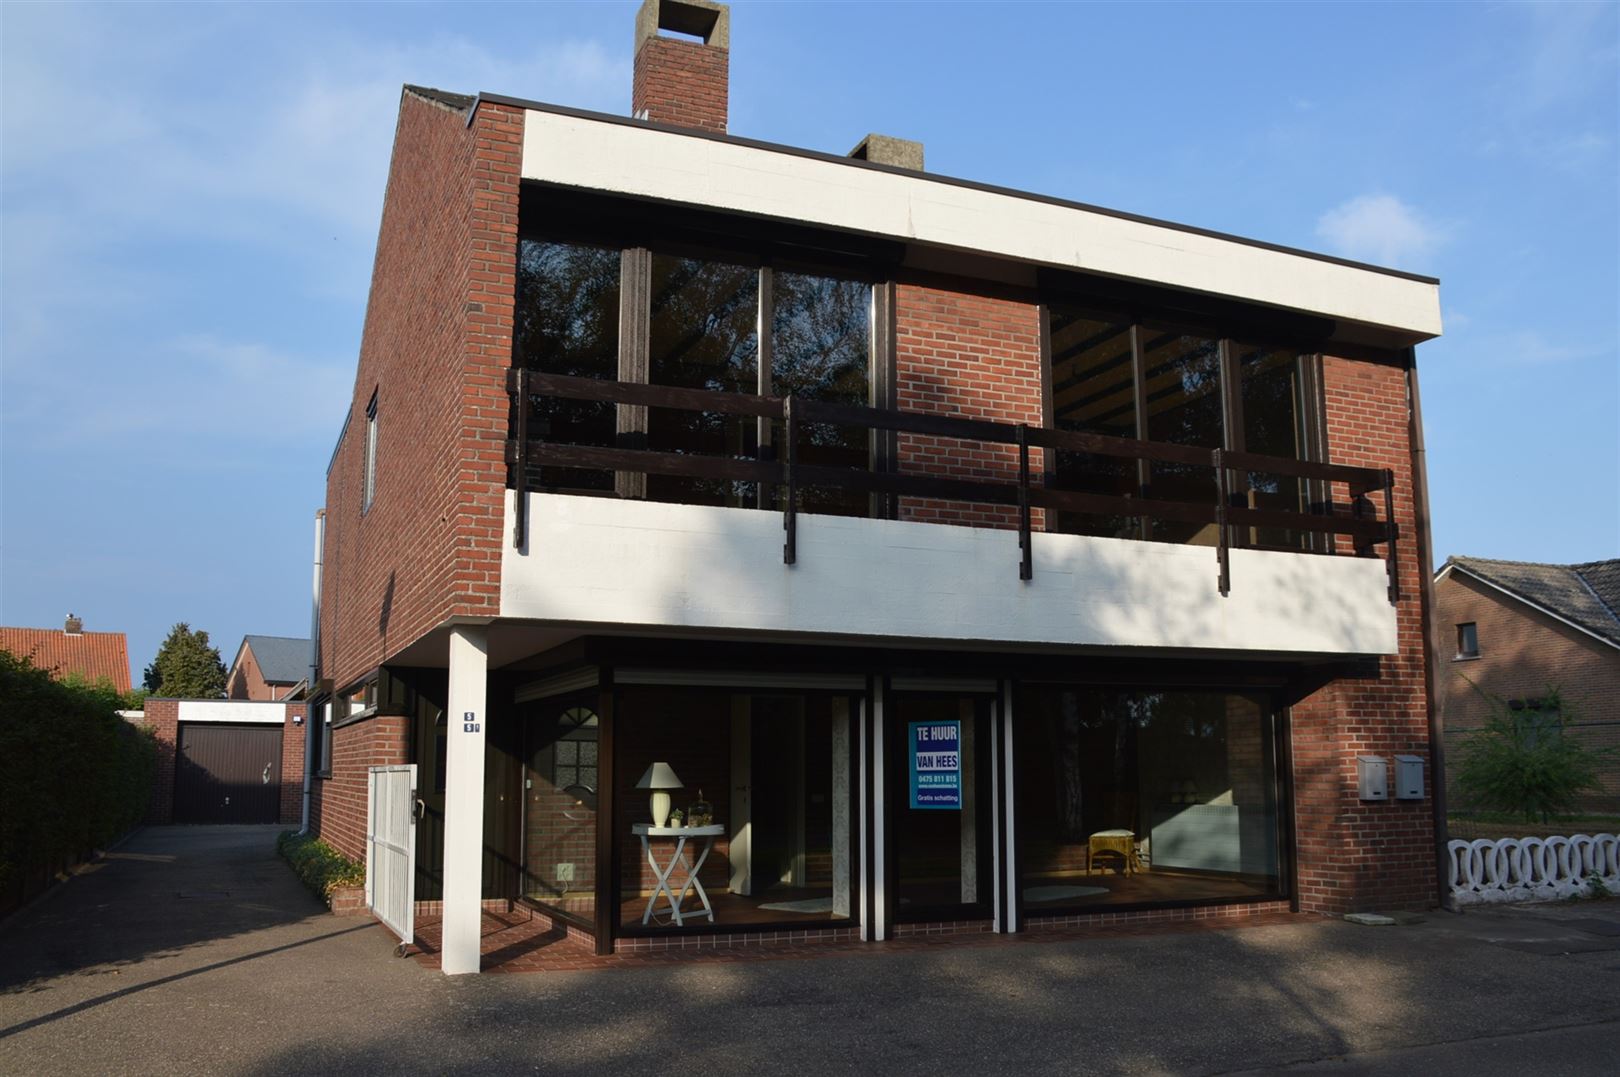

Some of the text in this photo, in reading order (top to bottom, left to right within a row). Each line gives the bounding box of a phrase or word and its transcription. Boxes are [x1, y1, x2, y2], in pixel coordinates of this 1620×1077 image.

[917, 726, 957, 741] TE HUUR
[917, 755, 958, 768] VAN HEES
[934, 794, 958, 802] schatting
